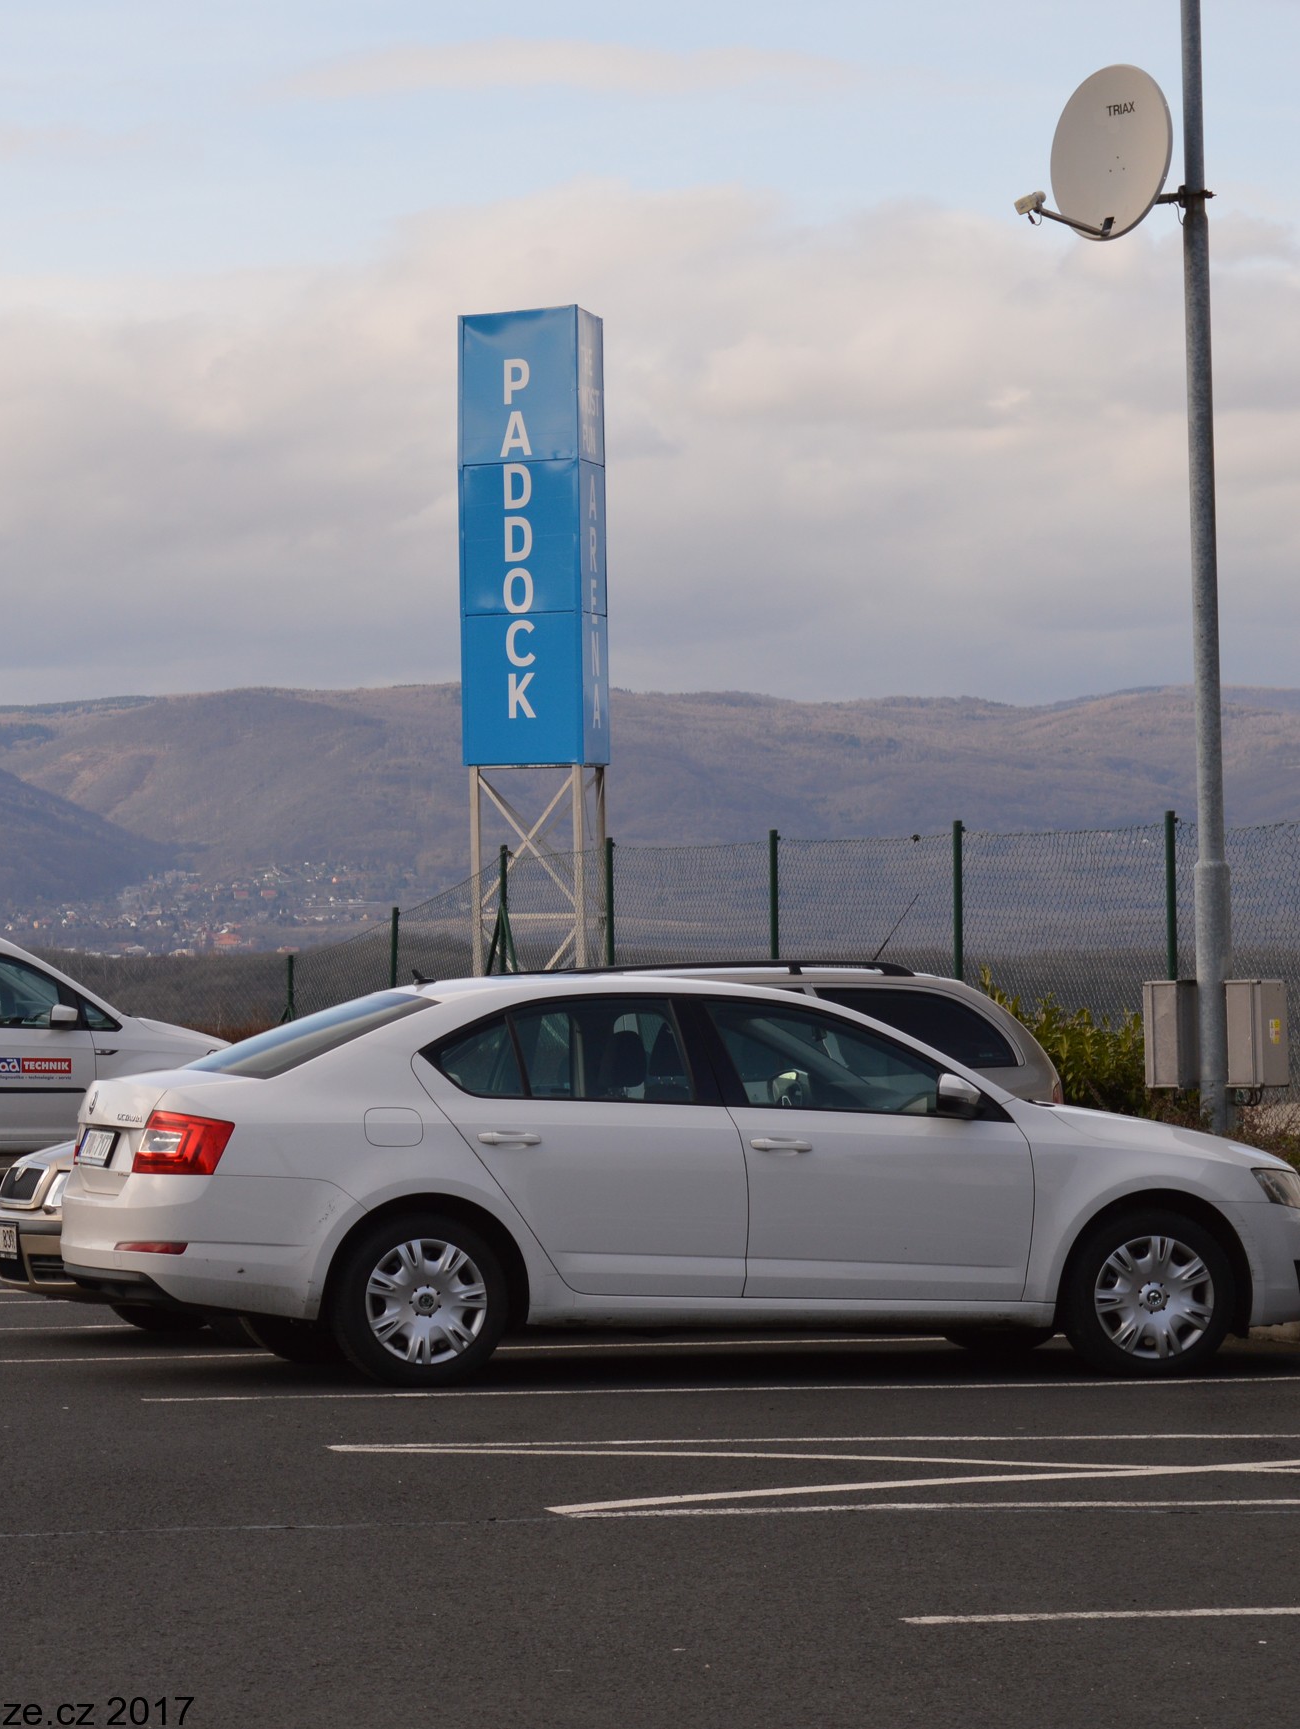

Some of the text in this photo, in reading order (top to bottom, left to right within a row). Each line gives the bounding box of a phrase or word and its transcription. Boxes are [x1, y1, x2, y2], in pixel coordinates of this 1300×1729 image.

[1106, 101, 1135, 117] TRIAX
[500, 358, 536, 719] PADDOCK
[588, 474, 601, 729] ARENA
[23, 1061, 70, 1071] TECHNIK
